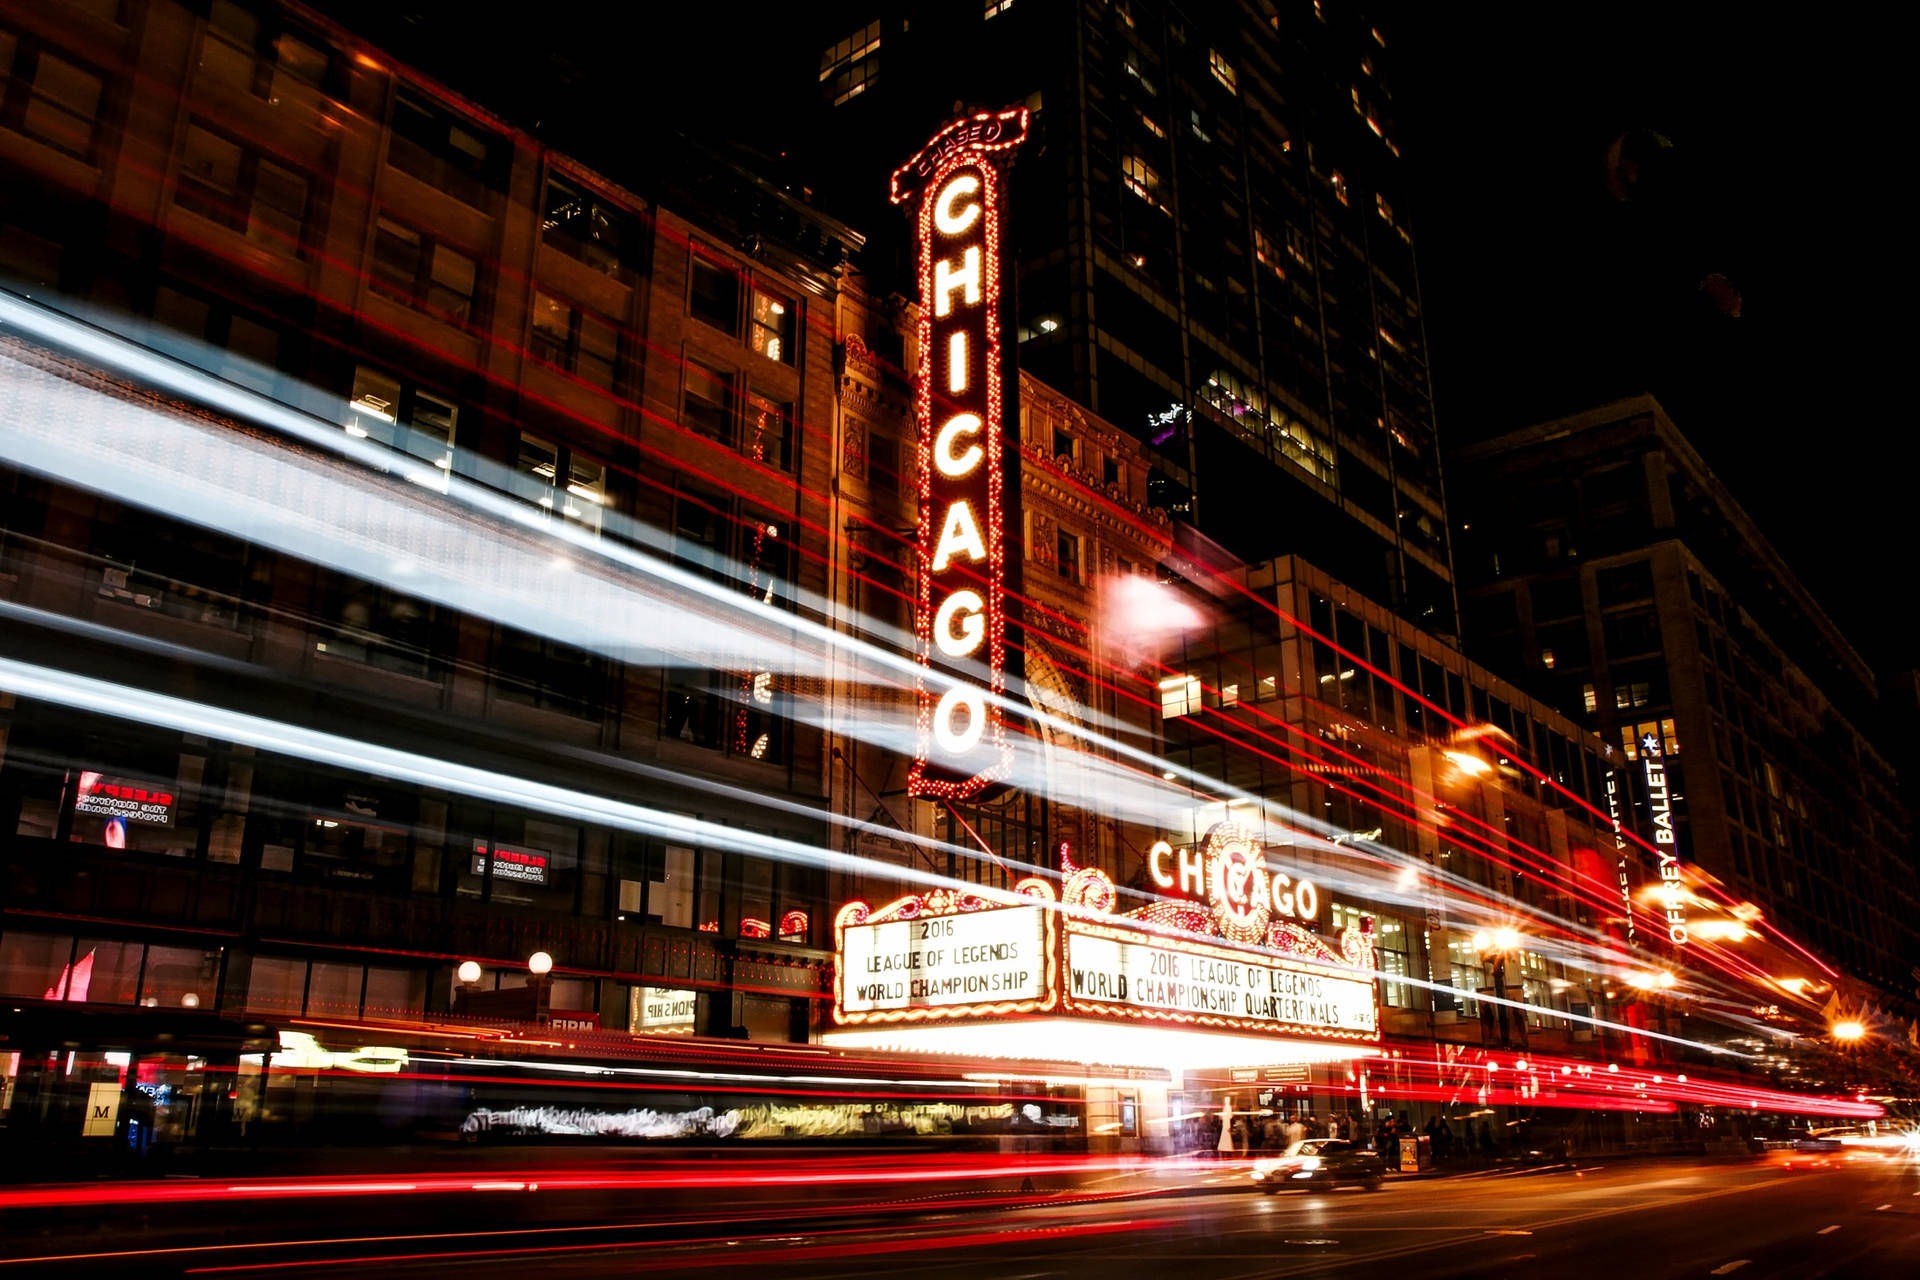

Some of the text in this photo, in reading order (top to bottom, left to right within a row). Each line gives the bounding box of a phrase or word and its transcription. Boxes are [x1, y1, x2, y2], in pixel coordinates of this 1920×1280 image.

[932, 175, 987, 755] CHICAGO
[1646, 758, 1676, 844] BALLET
[1150, 841, 1318, 920] CHICAGO
[920, 919, 955, 940] 2016
[867, 942, 1019, 973] LEAGUE OF LEGENDS
[1150, 951, 1323, 999] 2016 LEAGUE OF LEGENDS
[857, 971, 1029, 1002] WORLD CHAMPIONSHIP
[1073, 967, 1340, 1025] WORLD CHAMPIONSHIP QUARTERFINALS
[94, 1105, 110, 1118] M
